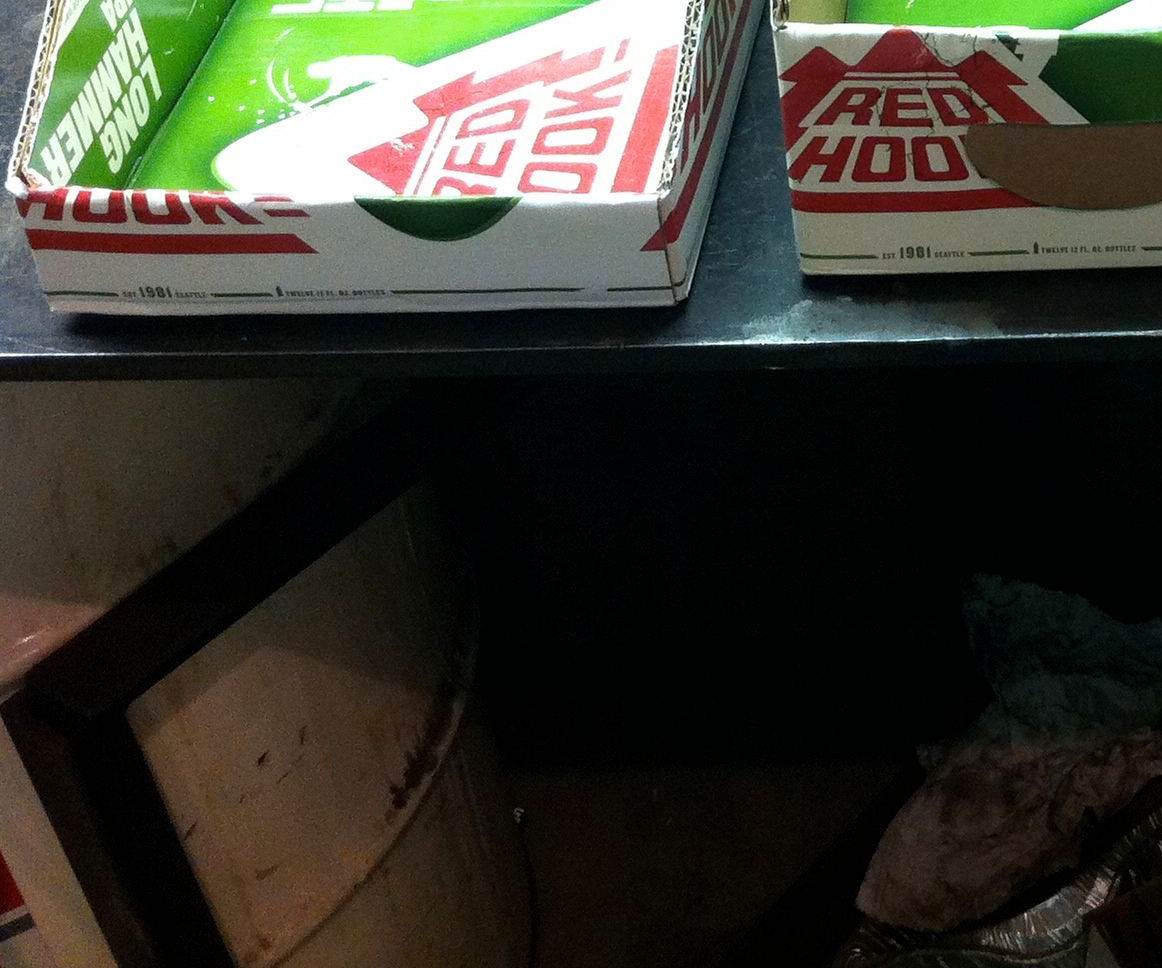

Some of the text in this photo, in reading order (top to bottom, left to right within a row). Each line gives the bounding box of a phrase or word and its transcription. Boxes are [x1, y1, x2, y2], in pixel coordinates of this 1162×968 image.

[40, 7, 149, 188] HAMMER
[99, 52, 163, 175] LONG
[813, 87, 990, 128] RED
[517, 69, 633, 195] OOK
[787, 135, 968, 183] HOO
[899, 246, 931, 259] 1981
[138, 286, 173, 298] 1981
